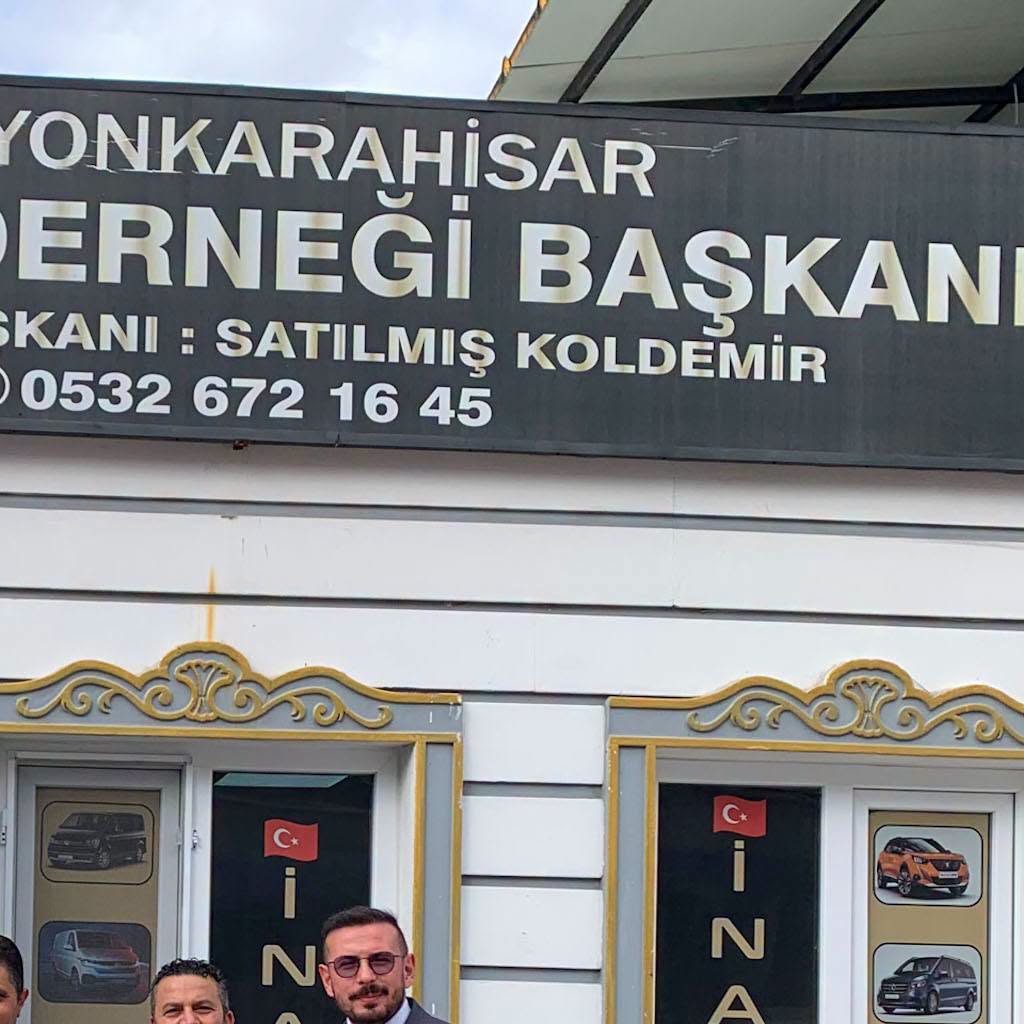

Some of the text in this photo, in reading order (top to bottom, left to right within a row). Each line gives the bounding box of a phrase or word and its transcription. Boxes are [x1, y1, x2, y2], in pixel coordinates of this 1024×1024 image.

[215, 318, 496, 378] SATILMIŞ
[517, 332, 827, 383] KOLDEMİR
[20, 369, 492, 428] 0532 672 16 45
